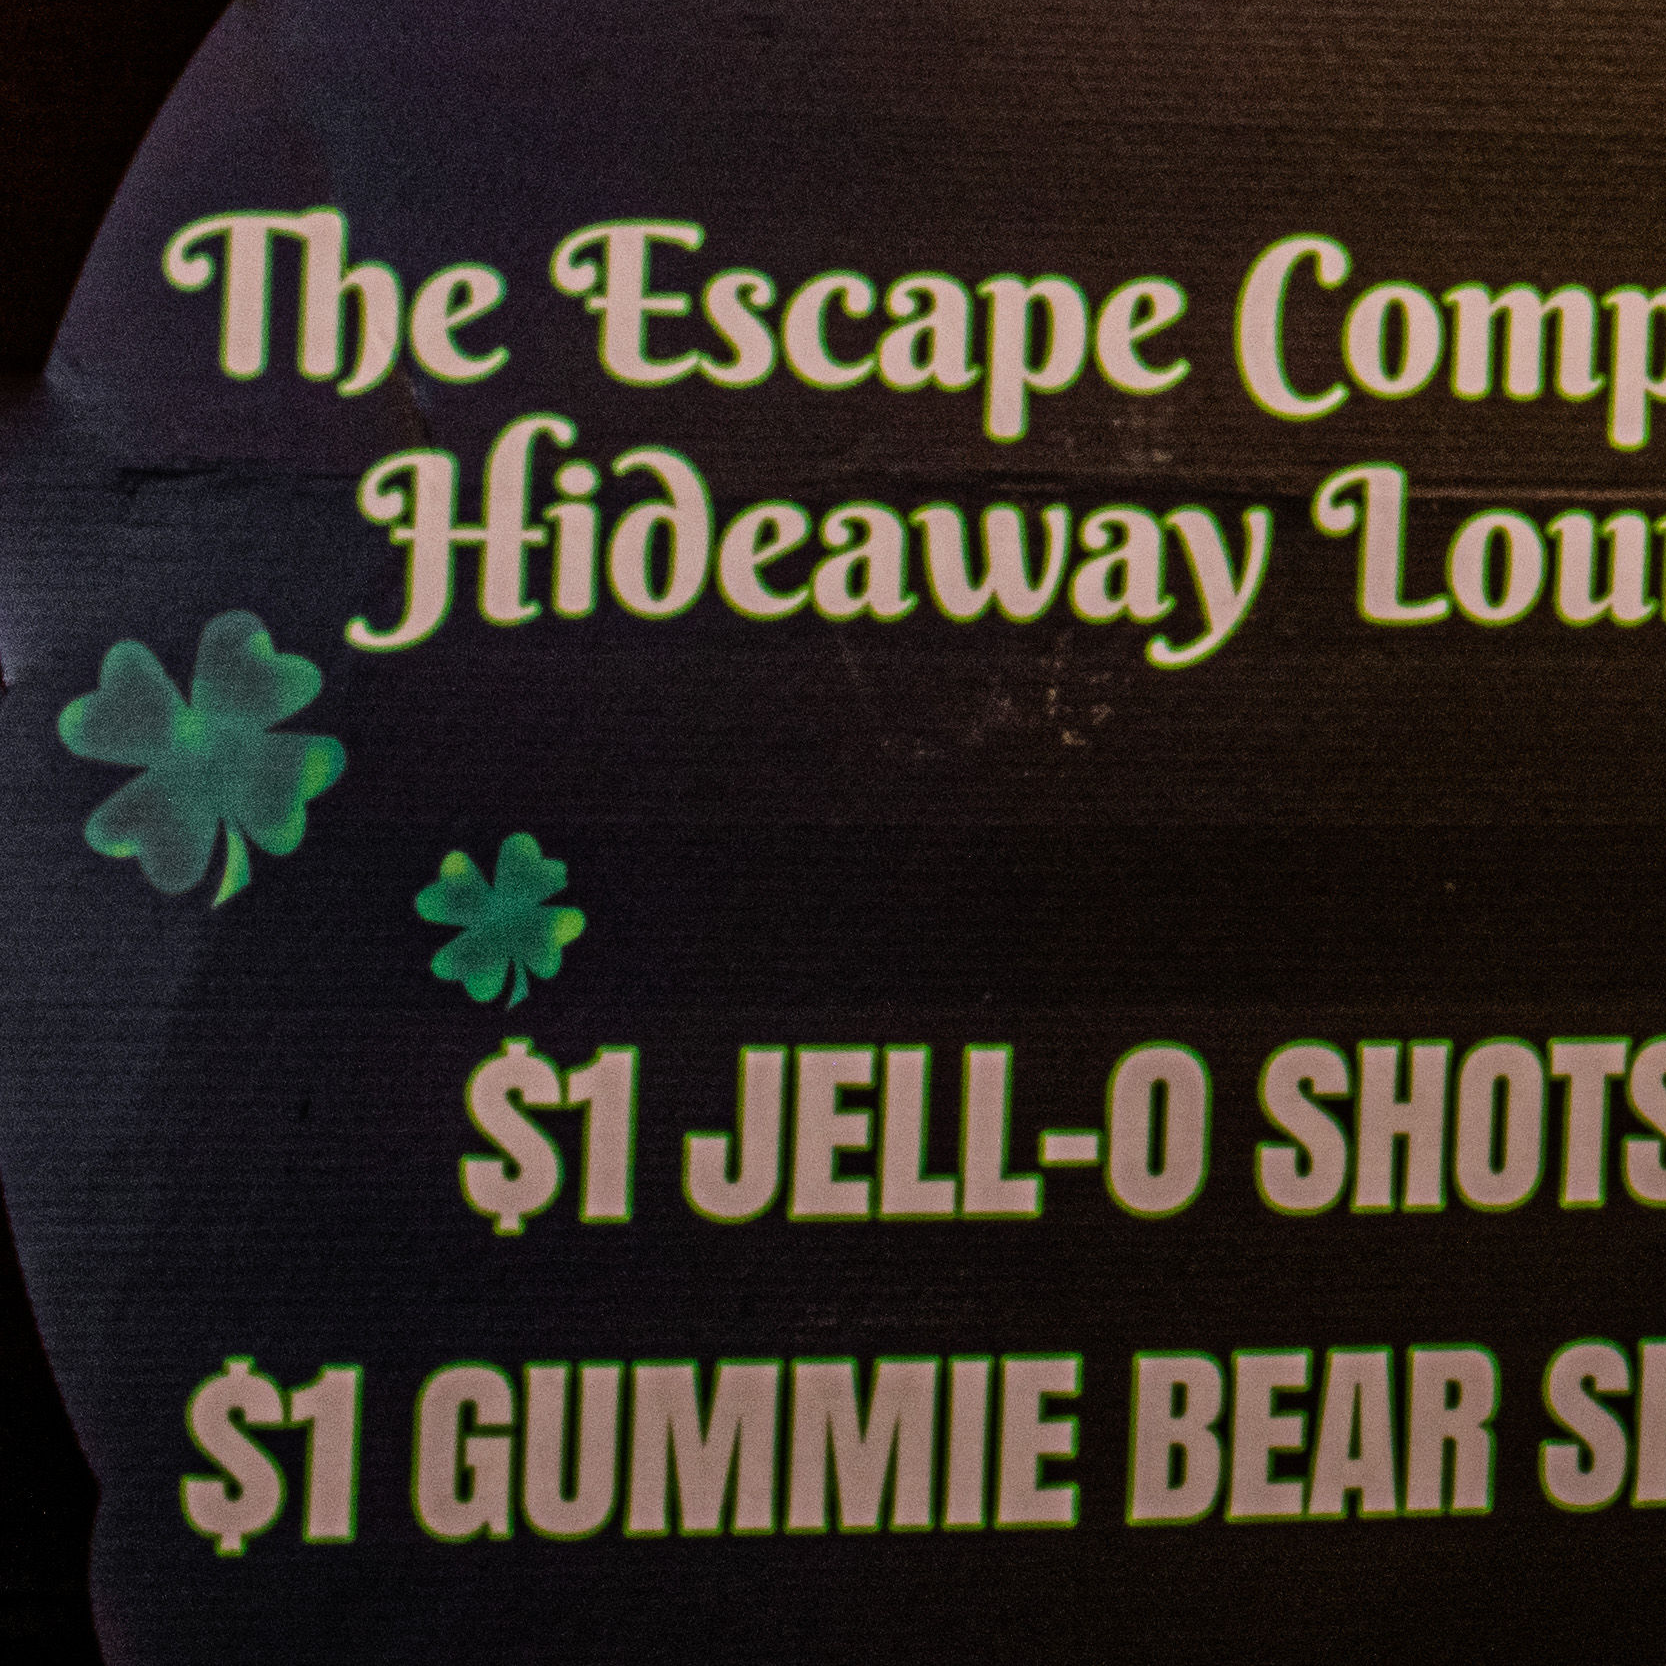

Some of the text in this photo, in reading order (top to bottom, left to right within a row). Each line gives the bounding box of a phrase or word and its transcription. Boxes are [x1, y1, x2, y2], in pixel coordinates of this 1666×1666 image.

[162, 207, 508, 397] The
[550, 220, 1190, 442] Escape
[345, 412, 1273, 669] Hideaway
[461, 1039, 638, 1233] $1
[685, 1043, 1209, 1221] JELL-O
[182, 1359, 360, 1553] $1
[415, 1357, 1080, 1538] GUMMIE
[1129, 1349, 1496, 1525] BEAR
